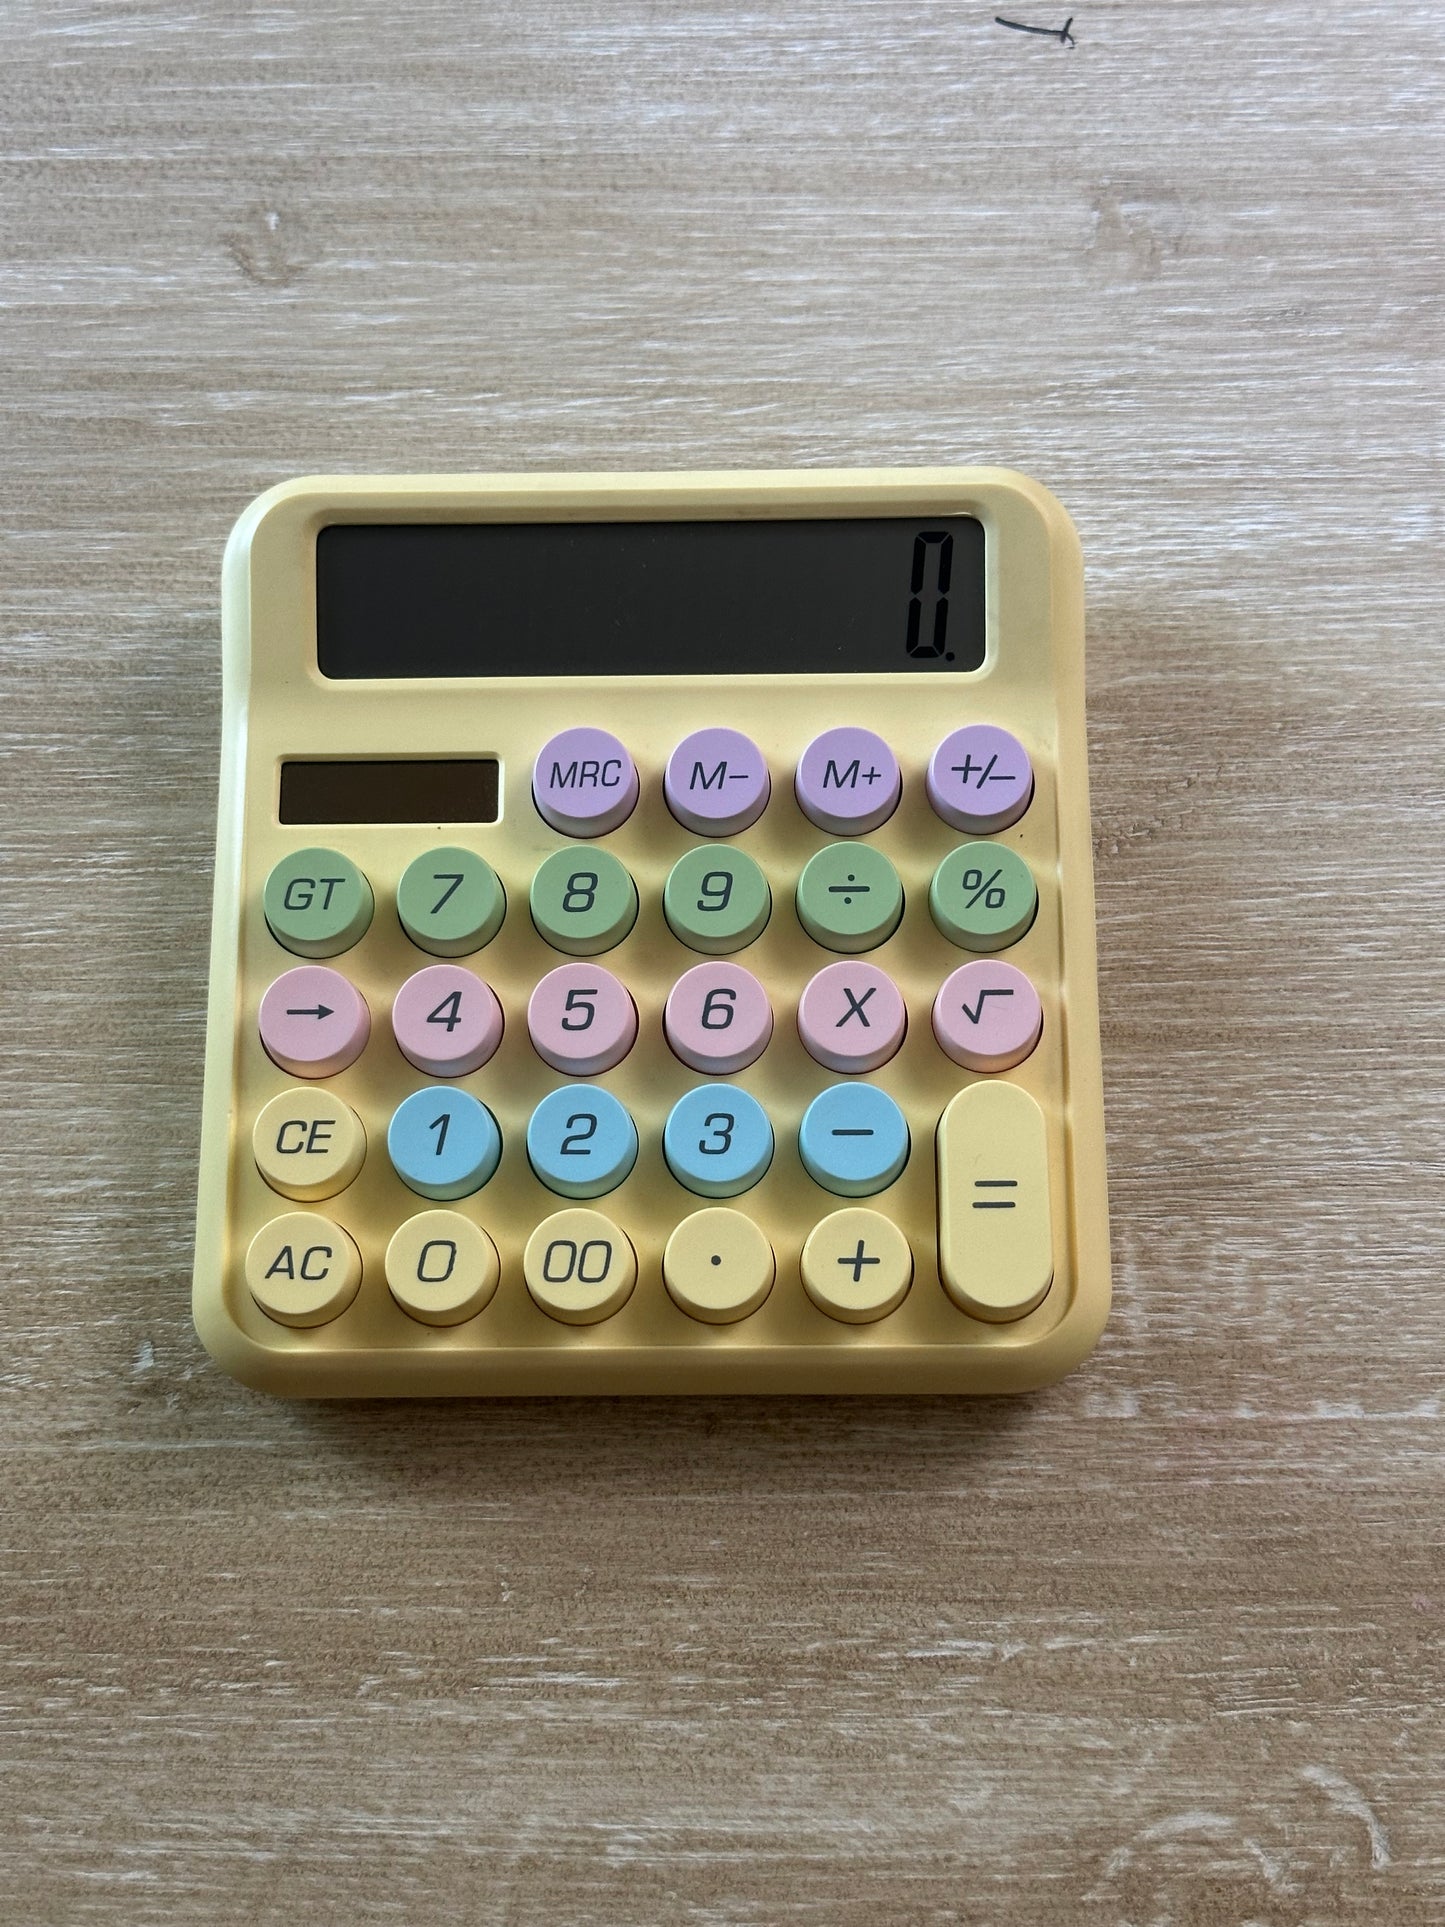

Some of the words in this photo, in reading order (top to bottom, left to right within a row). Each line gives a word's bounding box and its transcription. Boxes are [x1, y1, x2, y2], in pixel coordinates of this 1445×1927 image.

[906, 531, 955, 661] 0.
[550, 760, 621, 788] MRC
[690, 762, 748, 790] M-
[823, 760, 881, 788] M+
[951, 754, 1016, 789] +/-
[284, 879, 345, 910] GT
[431, 874, 464, 914] 7
[563, 872, 598, 912] 8
[697, 872, 733, 911] 9
[829, 875, 870, 904] ÷
[963, 869, 1005, 908] %
[426, 991, 462, 1032] 4
[562, 989, 598, 1031] 5
[702, 989, 736, 1029] 6
[276, 1120, 336, 1154] CE
[429, 1114, 450, 1155] 1
[560, 1114, 597, 1155] 2
[699, 1113, 734, 1154] 3
[972, 1181, 1018, 1208] =
[265, 1246, 332, 1280] AC
[417, 1240, 457, 1282] 0
[543, 1240, 612, 1283] 00
[837, 1240, 880, 1282] +
